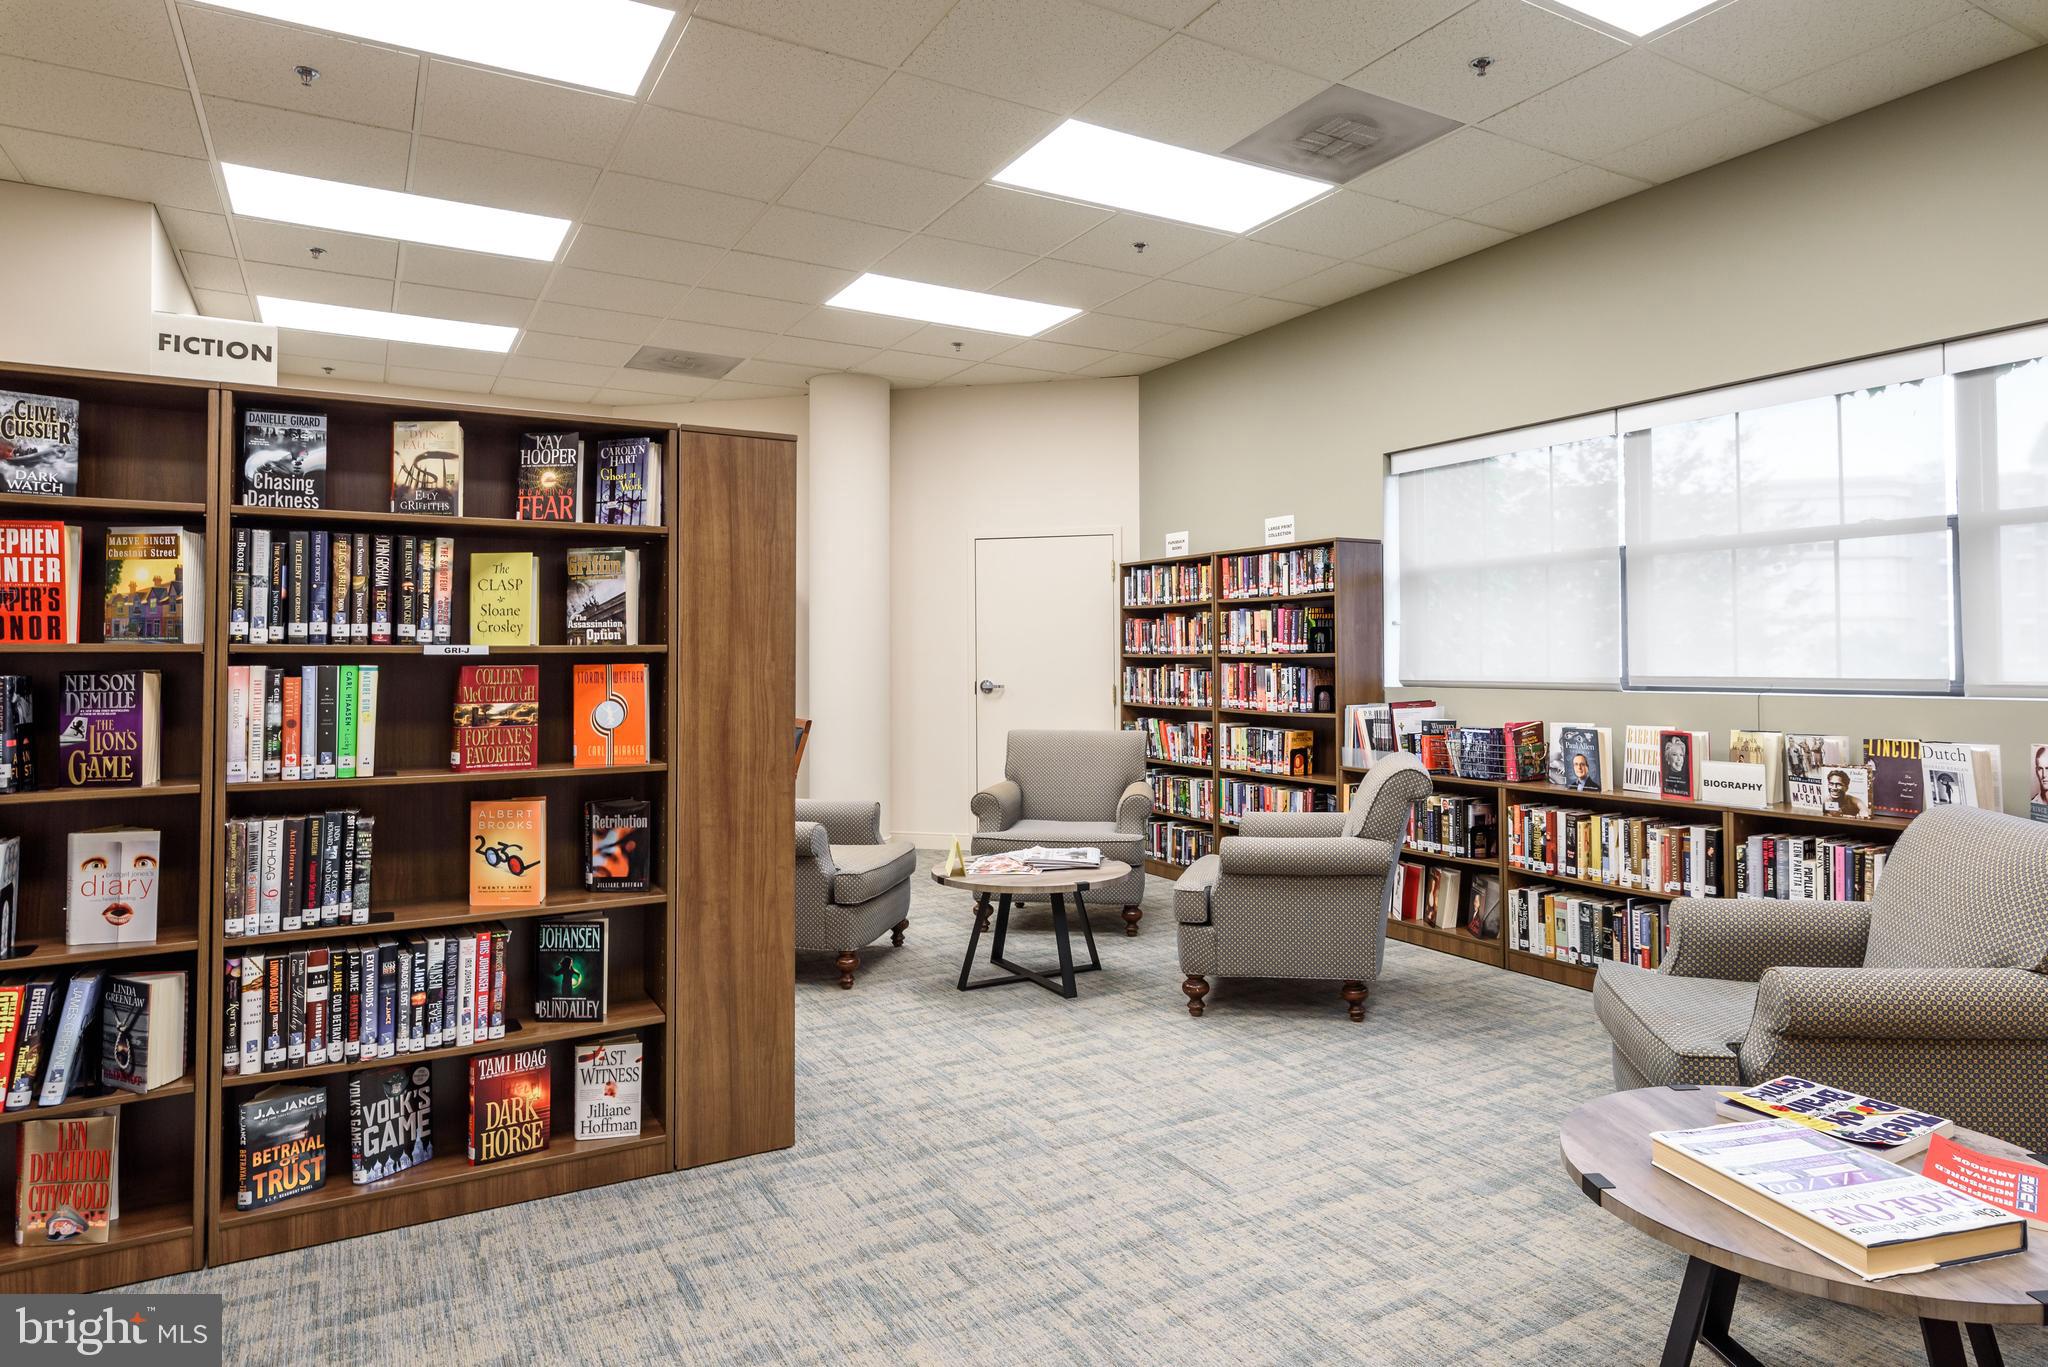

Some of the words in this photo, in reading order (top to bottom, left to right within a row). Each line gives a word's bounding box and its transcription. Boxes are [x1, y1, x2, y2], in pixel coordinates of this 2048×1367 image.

[158, 333, 272, 363] FICTION
[15, 400, 57, 422] CLIVE
[249, 412, 286, 426] DANIELLE
[290, 414, 321, 427] GIRARD
[1, 416, 70, 444] CUSSLER
[536, 435, 563, 449] KAY
[521, 449, 576, 465] HOOPER
[600, 445, 645, 459] CAROLYN
[610, 455, 637, 467] HART
[16, 470, 58, 482] DARK
[253, 472, 315, 495] Chasing
[600, 468, 627, 481] Ghost
[7, 480, 63, 493] WATCH
[620, 479, 642, 491] Work
[248, 490, 320, 510] Darkness
[400, 500, 450, 511] GRIFFITHS
[518, 496, 574, 521] FEAR
[0, 528, 59, 554] EPHEN
[109, 536, 139, 546] MAEVE
[144, 536, 176, 546] BINCHY
[108, 548, 147, 557] Chestnut
[150, 548, 176, 557] Street
[237, 542, 247, 572] BROKER
[337, 540, 346, 573] PELICAN
[0, 557, 60, 582] NTER
[295, 555, 303, 579] CLIENT
[493, 563, 510, 574] The
[568, 556, 621, 575] Griffin
[477, 579, 523, 591] CLASP
[0, 587, 60, 611] PER'S
[480, 603, 521, 616] Sloane
[477, 621, 523, 636] Crosley
[568, 620, 623, 629] Assassination
[586, 629, 621, 642] Option
[65, 674, 136, 691] NELSON
[476, 668, 524, 684] COLLEEN
[577, 671, 605, 685] STORMY
[612, 671, 645, 685] WEATHER
[65, 692, 136, 716] DEMILLE
[463, 686, 535, 703] McCULLOUGH
[96, 720, 114, 730] THE
[88, 725, 137, 755] LION'S
[465, 728, 532, 746] FORTUNE'S
[1565, 742, 1577, 750] Paul
[466, 745, 531, 764] FAVORITES
[588, 745, 605, 757] CARL
[614, 745, 645, 757] HIAASEN
[1626, 746, 1660, 765] WALTER
[1869, 739, 1922, 760] LINCOL
[1922, 745, 1967, 762] Dutch
[68, 750, 133, 786] GAME
[1625, 767, 1661, 785] AUDITIO
[1703, 779, 1763, 791] BIOGRAPHY
[1797, 784, 1822, 795] JOHN
[1792, 792, 1822, 805] McCAI
[479, 810, 533, 819] ALBERT
[593, 815, 648, 829] Retribution
[478, 821, 533, 830] BROOKS
[268, 824, 277, 848] TAMI
[1793, 843, 1803, 858] LEON
[265, 850, 276, 880] HOAG
[1793, 860, 1803, 886] PANETTA
[1736, 862, 1746, 889] Nelson
[1804, 867, 1813, 898] PAPILLON
[81, 875, 153, 899] diary
[540, 928, 600, 948] JOHANSEN
[366, 954, 375, 973] EXIT
[333, 970, 343, 992] JANCE
[350, 969, 359, 992] JANCE
[415, 968, 425, 992] JANCE
[478, 956, 488, 992] JOHANSEN
[105, 992, 145, 1007] GREENLAW
[113, 983, 136, 997] LINDA
[365, 974, 375, 1008] WOUNDS
[63, 987, 84, 1020] JAMES
[540, 1000, 569, 1018] BLIND
[569, 1000, 600, 1018] ALLEY
[479, 1054, 511, 1078] TAMI
[515, 1049, 547, 1069] HOAG
[592, 1050, 627, 1067] LAST
[581, 1067, 640, 1085] WITNESS
[254, 1105, 279, 1120] J.A.
[280, 1093, 325, 1112] JANCE
[350, 1080, 361, 1116] VOLK'S
[363, 1086, 431, 1128] VOLK'S
[1786, 1088, 1855, 1114] Brain
[486, 1096, 541, 1131] DARK
[587, 1103, 631, 1119] Jilliane
[350, 1119, 362, 1146] GAME
[363, 1107, 431, 1157] GAME
[581, 1117, 638, 1134] Hoffman
[1889, 1112, 1944, 1134] The
[58, 1121, 89, 1152] LEN
[481, 1121, 544, 1161] HORSE
[253, 1135, 324, 1167] BETRAYAL
[279, 1155, 299, 1166] OF
[30, 1151, 112, 1183] DEIGHTON
[253, 1156, 323, 1199] TRUST
[28, 1184, 60, 1212] CITY
[72, 1183, 109, 1211] GOLD
[301, 1185, 313, 1193] NOVEL
[1809, 1203, 1895, 1226] ONE
[1973, 1208, 2007, 1219] The
